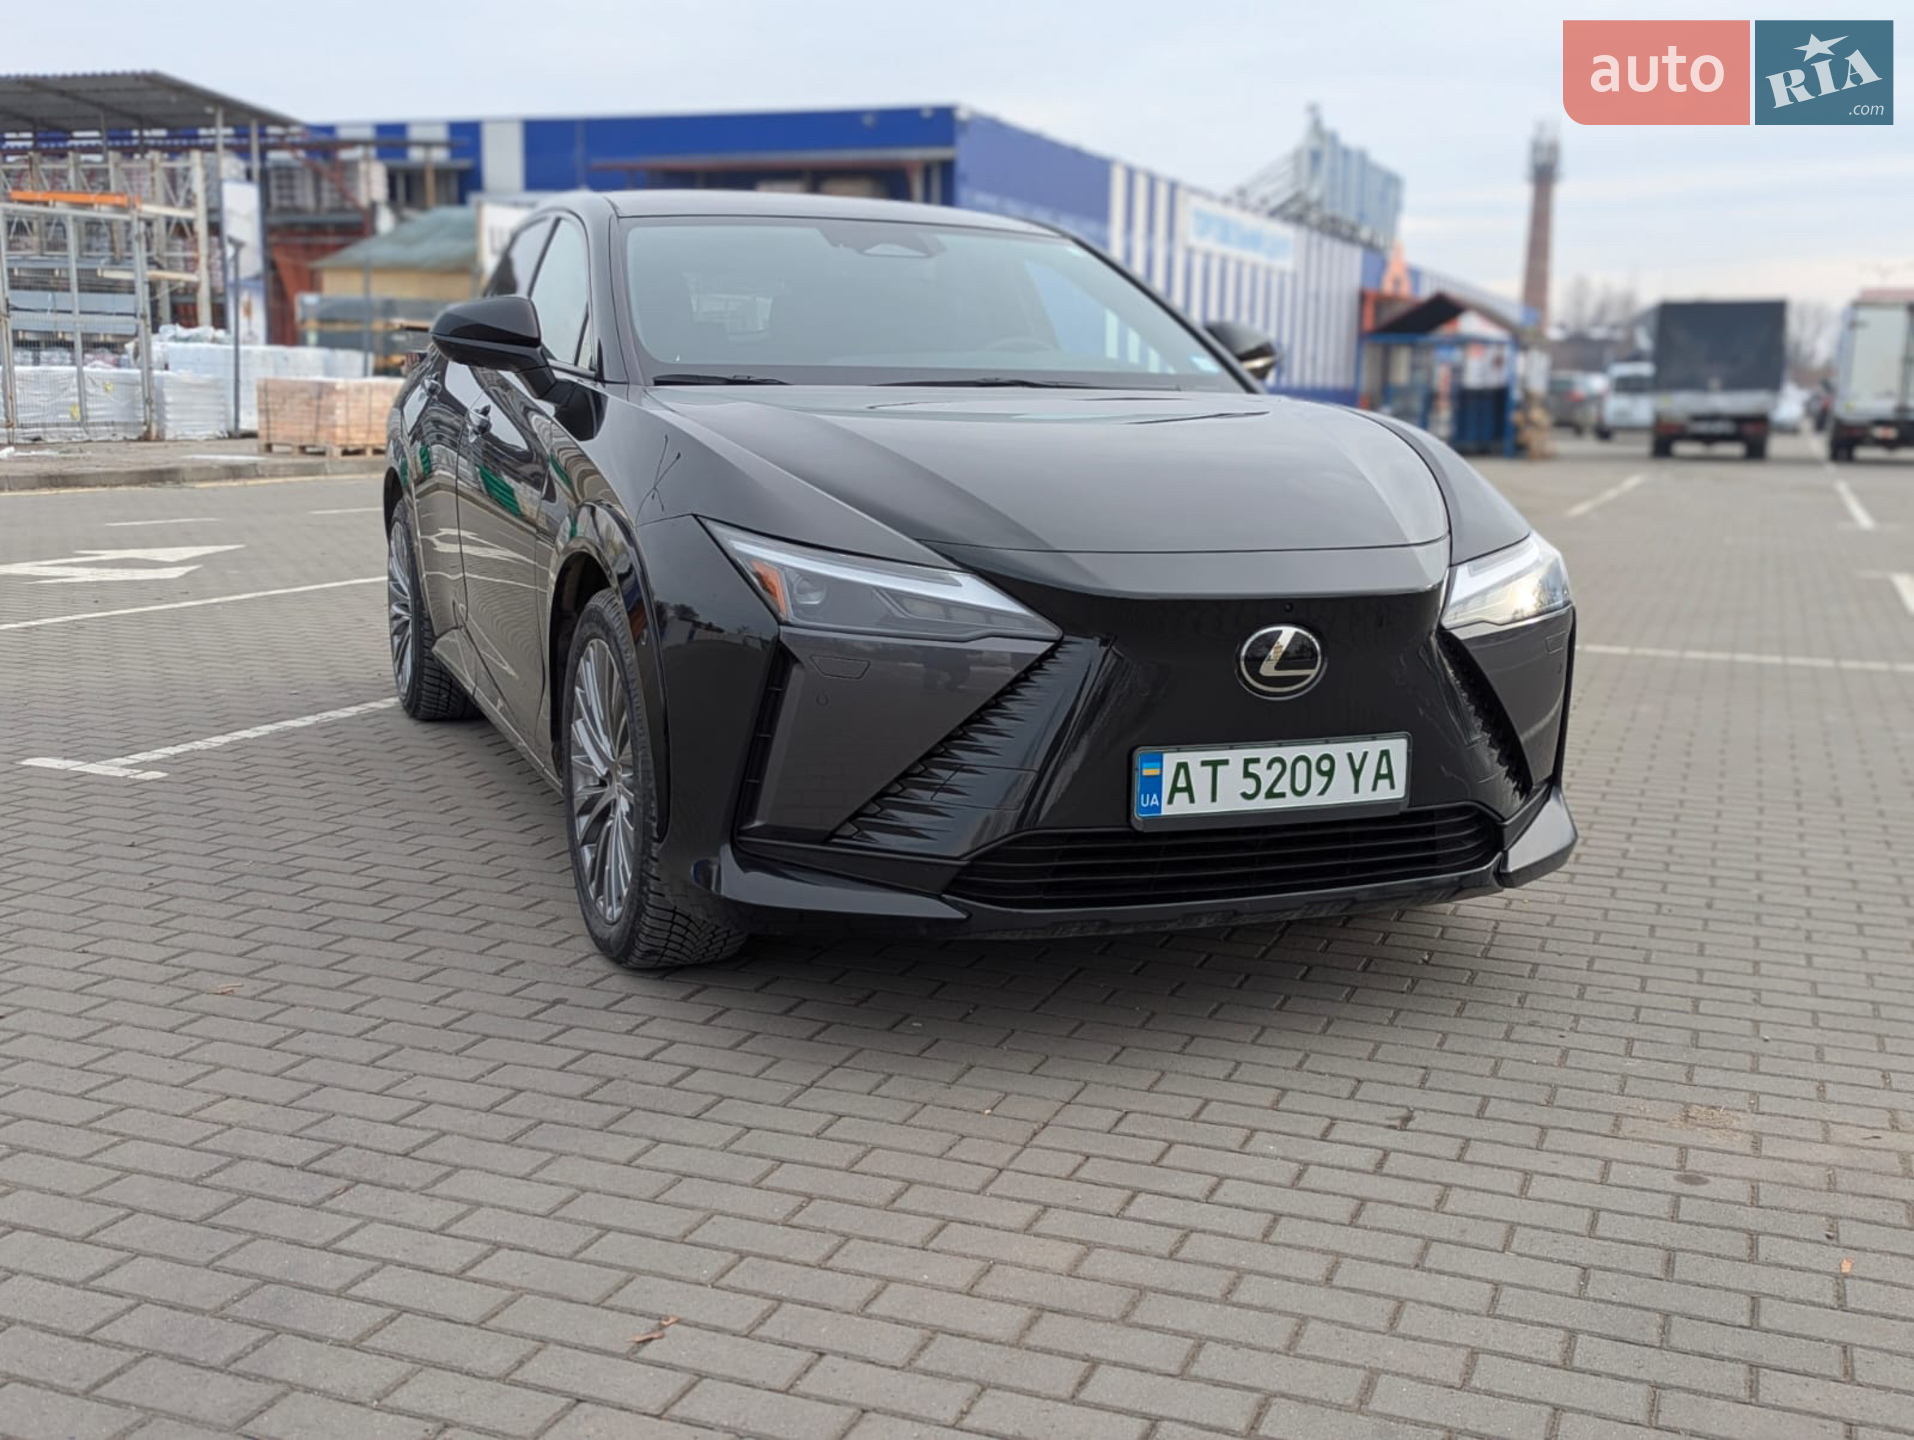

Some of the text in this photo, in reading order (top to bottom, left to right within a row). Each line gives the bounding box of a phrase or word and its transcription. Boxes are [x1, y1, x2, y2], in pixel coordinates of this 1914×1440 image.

[1166, 748, 1396, 806] AT 5209 YA
[1140, 793, 1160, 808] UA
